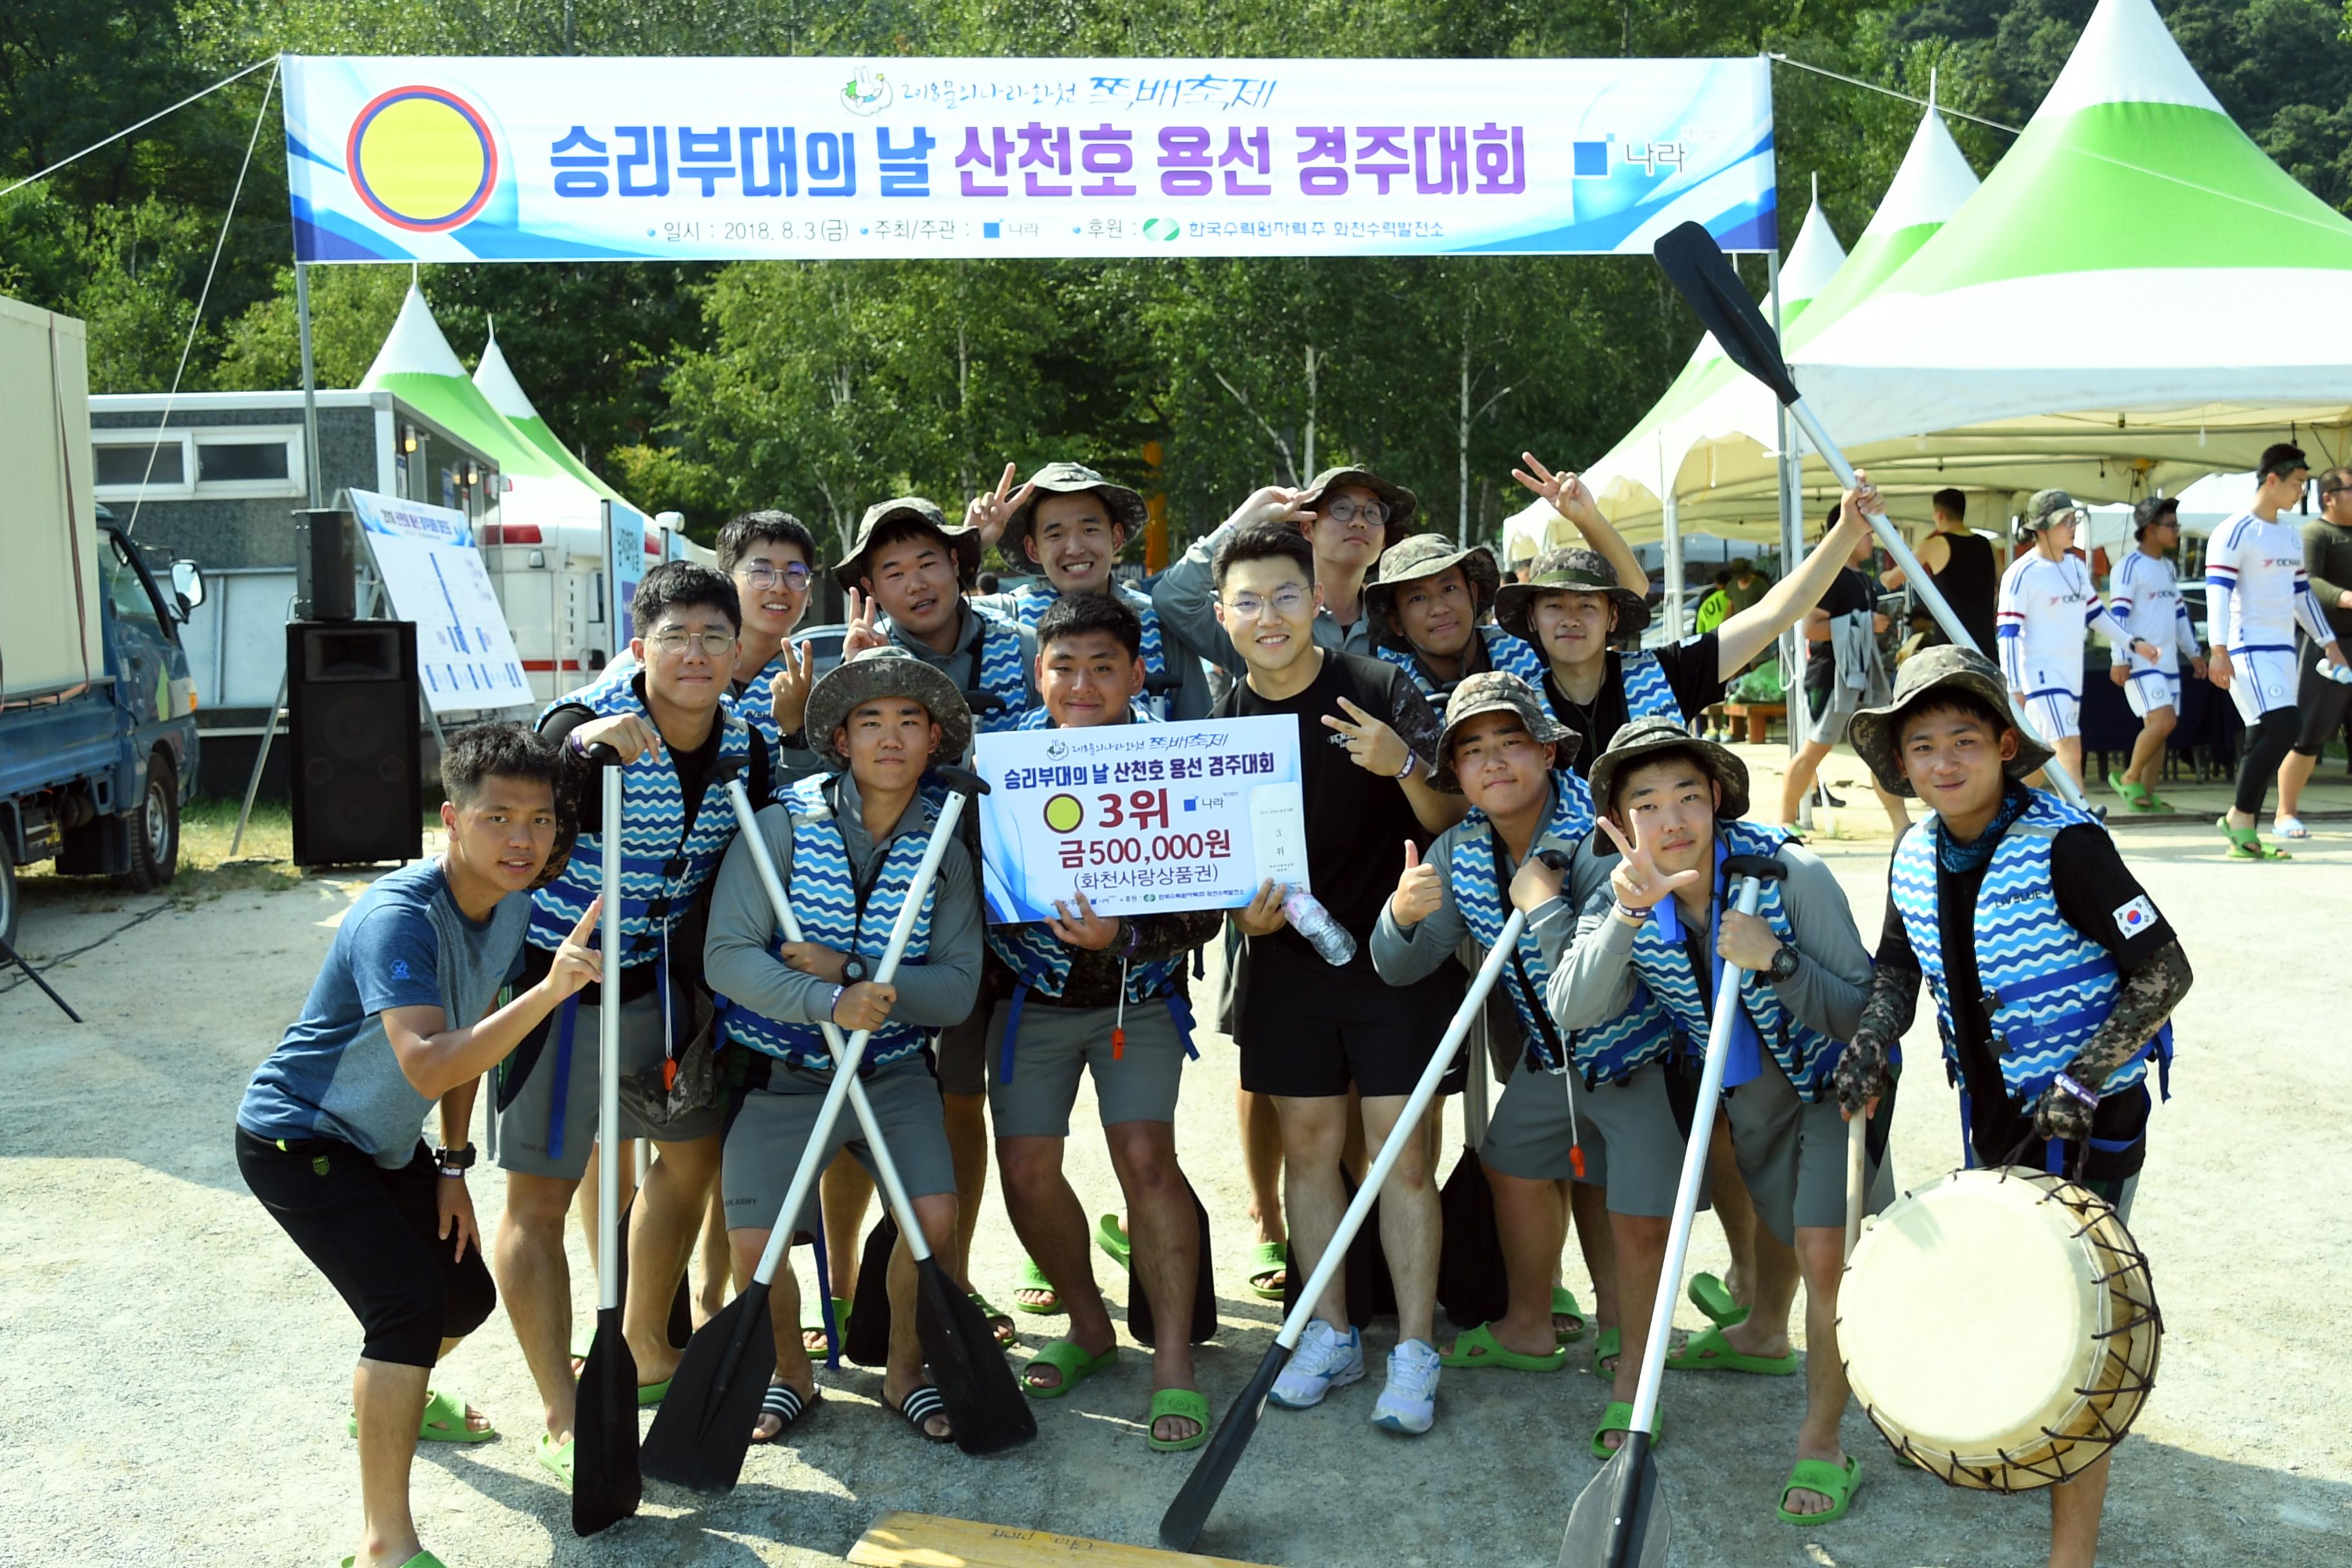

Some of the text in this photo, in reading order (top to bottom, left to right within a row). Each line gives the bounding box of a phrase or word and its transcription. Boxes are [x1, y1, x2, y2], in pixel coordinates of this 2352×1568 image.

[549, 122, 1526, 198] 승리부대의 날 산천호 용선 경주대회
[1625, 142, 1686, 175] 나라
[664, 222, 699, 242] 일시
[874, 220, 955, 240] 주최/주관
[1008, 222, 1039, 238] 나라
[1087, 219, 1122, 239] 후원
[1333, 221, 1446, 238] 화천수력발전소
[1004, 751, 1275, 790] 승리부대의 날 산천호 용선 경주대회
[1097, 788, 1169, 831] 3위
[1201, 797, 1224, 809] 나라
[1058, 829, 1231, 868] 금500,000원
[1073, 863, 1219, 892] (화천사랑상품권)
